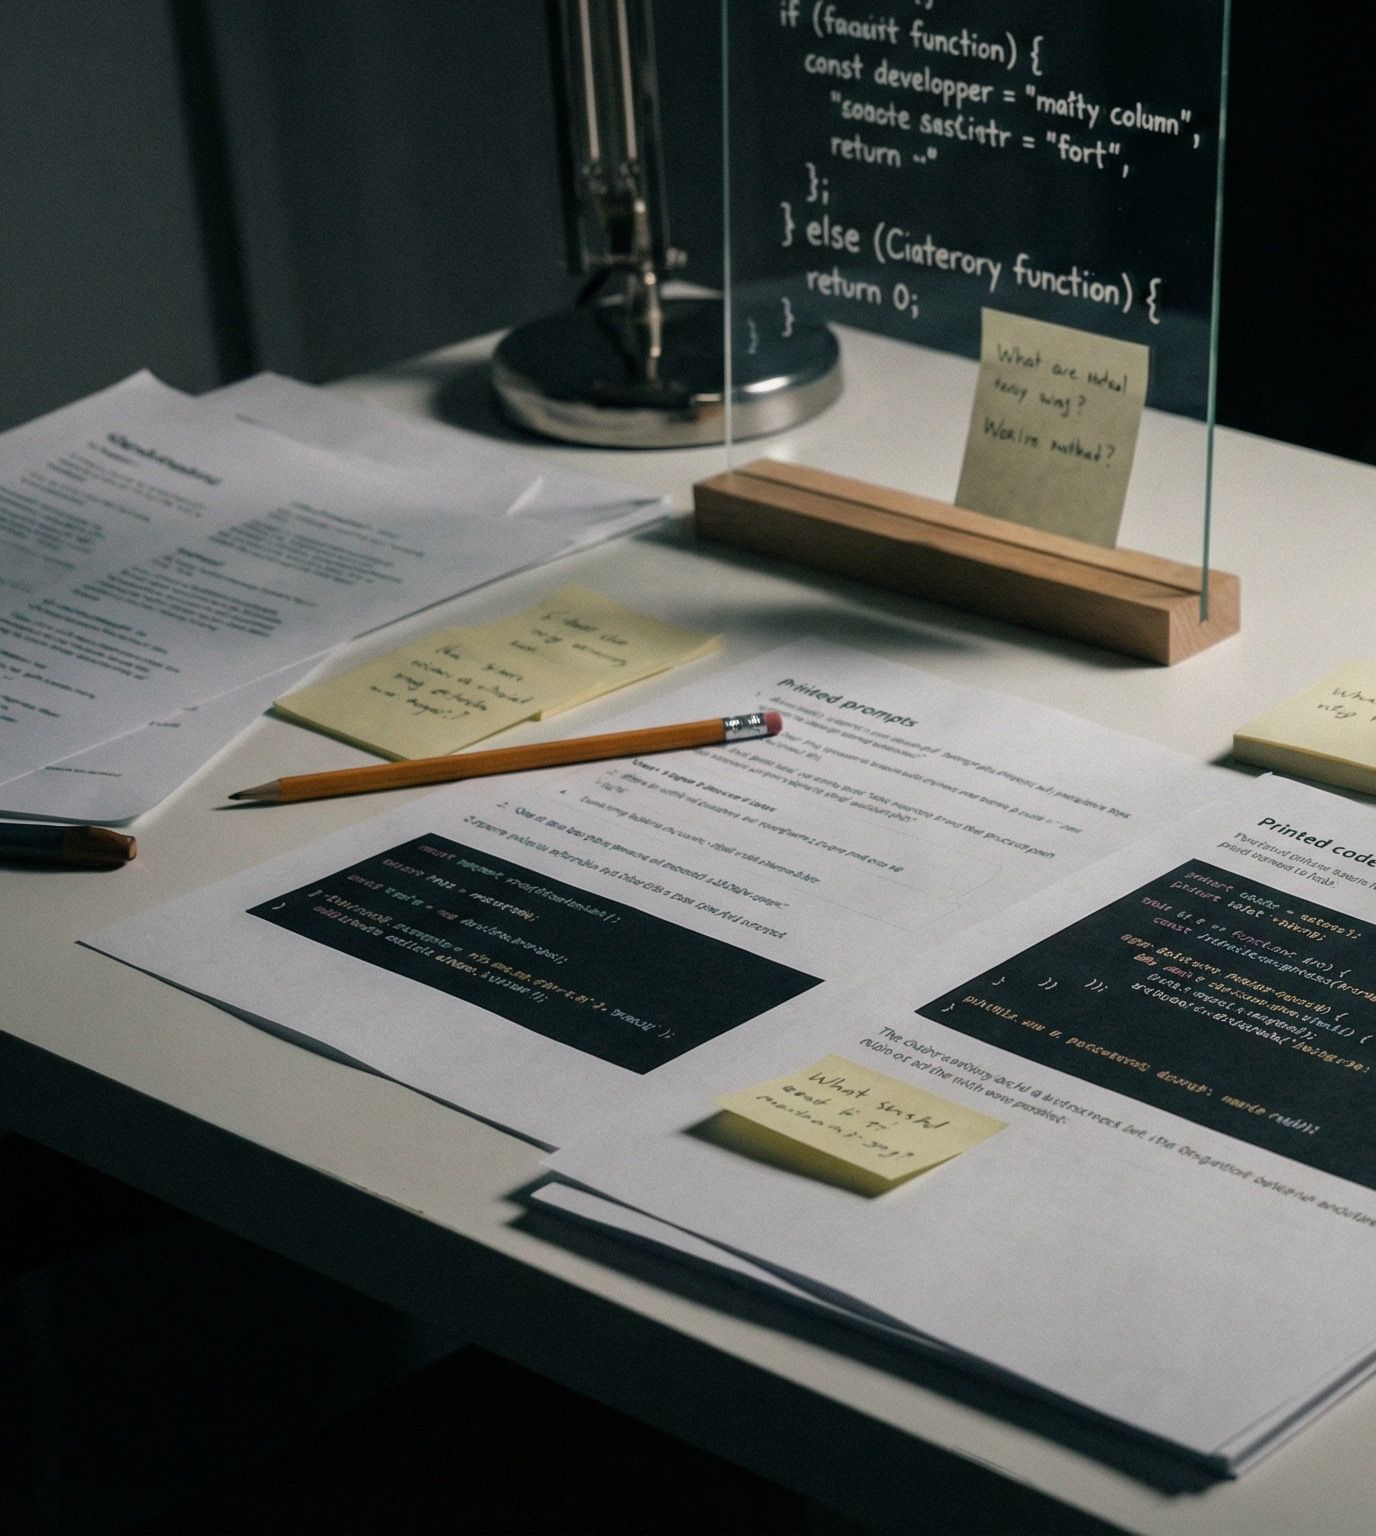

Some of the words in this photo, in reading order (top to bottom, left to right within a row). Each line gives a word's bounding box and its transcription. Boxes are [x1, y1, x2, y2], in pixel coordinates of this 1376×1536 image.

[910, 19, 1017, 70] function)
[804, 53, 863, 80] const
[874, 58, 993, 110] developper
[830, 133, 900, 167] return
[806, 214, 860, 253] else
[1013, 253, 1131, 313] function)
[806, 266, 882, 305] return
[839, 700, 919, 727] prompts
[1258, 817, 1333, 849] Printed
